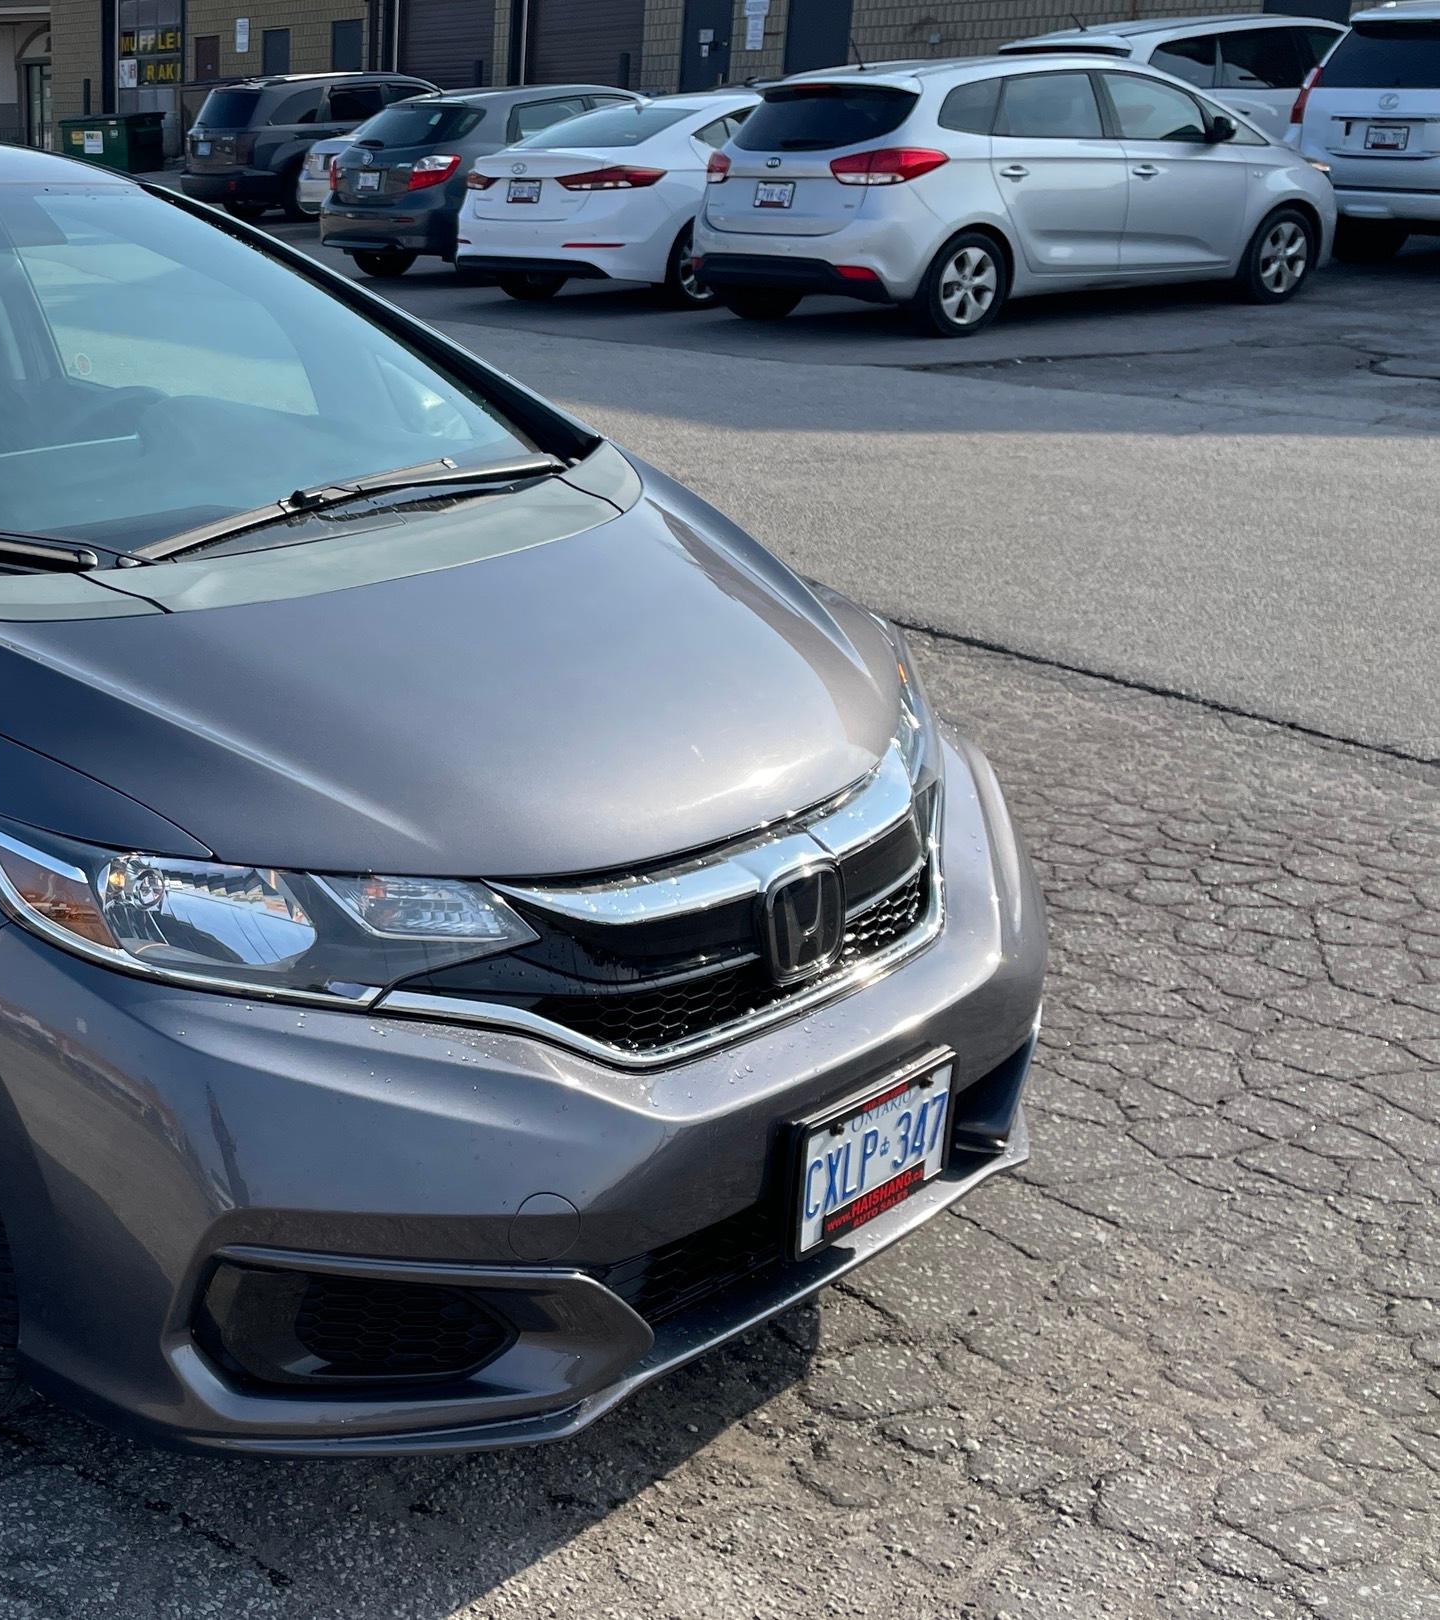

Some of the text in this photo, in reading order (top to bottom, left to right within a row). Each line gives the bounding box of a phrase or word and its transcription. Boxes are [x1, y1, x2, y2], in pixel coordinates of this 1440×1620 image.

[805, 1088, 948, 1219] CXLP 347
[852, 1208, 879, 1228] AUTO
